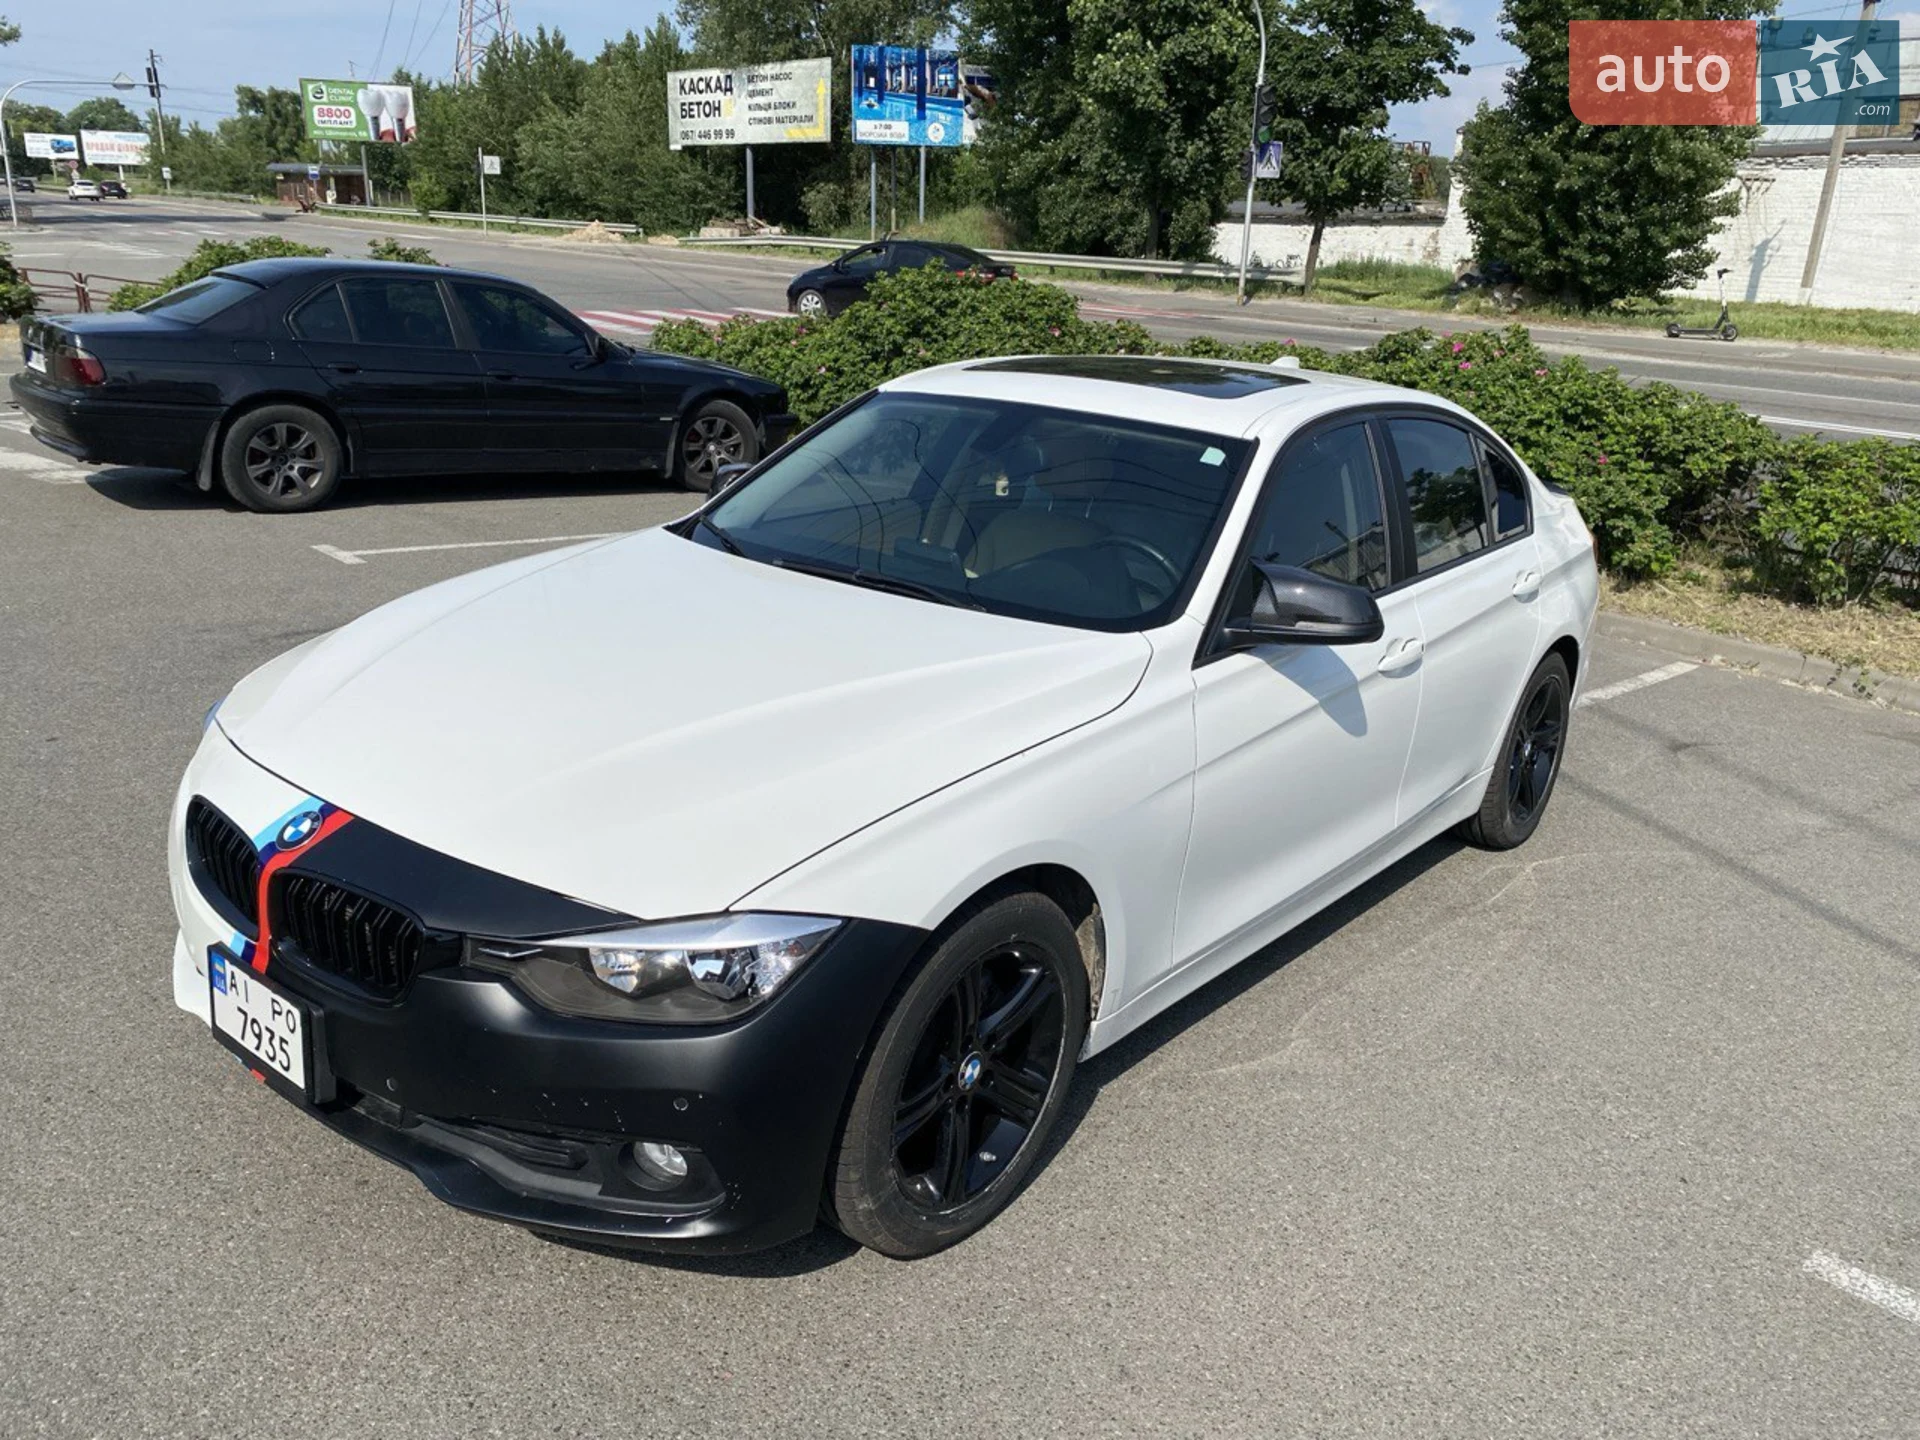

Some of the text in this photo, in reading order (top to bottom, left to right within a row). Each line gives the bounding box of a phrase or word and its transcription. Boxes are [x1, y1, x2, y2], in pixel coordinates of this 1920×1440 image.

[747, 72, 793, 84] БЕТОН НАСОС
[679, 74, 733, 96] КАСКАД
[747, 88, 774, 99] ЦЕМЕНТ
[680, 100, 721, 119] БЕТОН
[773, 101, 797, 110] БЛОКИ
[317, 108, 352, 119] 8800
[775, 114, 814, 125] МАТЕРІАЛИ
[697, 129, 711, 140] 446
[714, 129, 723, 140] 99
[726, 128, 735, 139] 99
[229, 971, 297, 1034] AI PO
[237, 1007, 291, 1072] 7935
